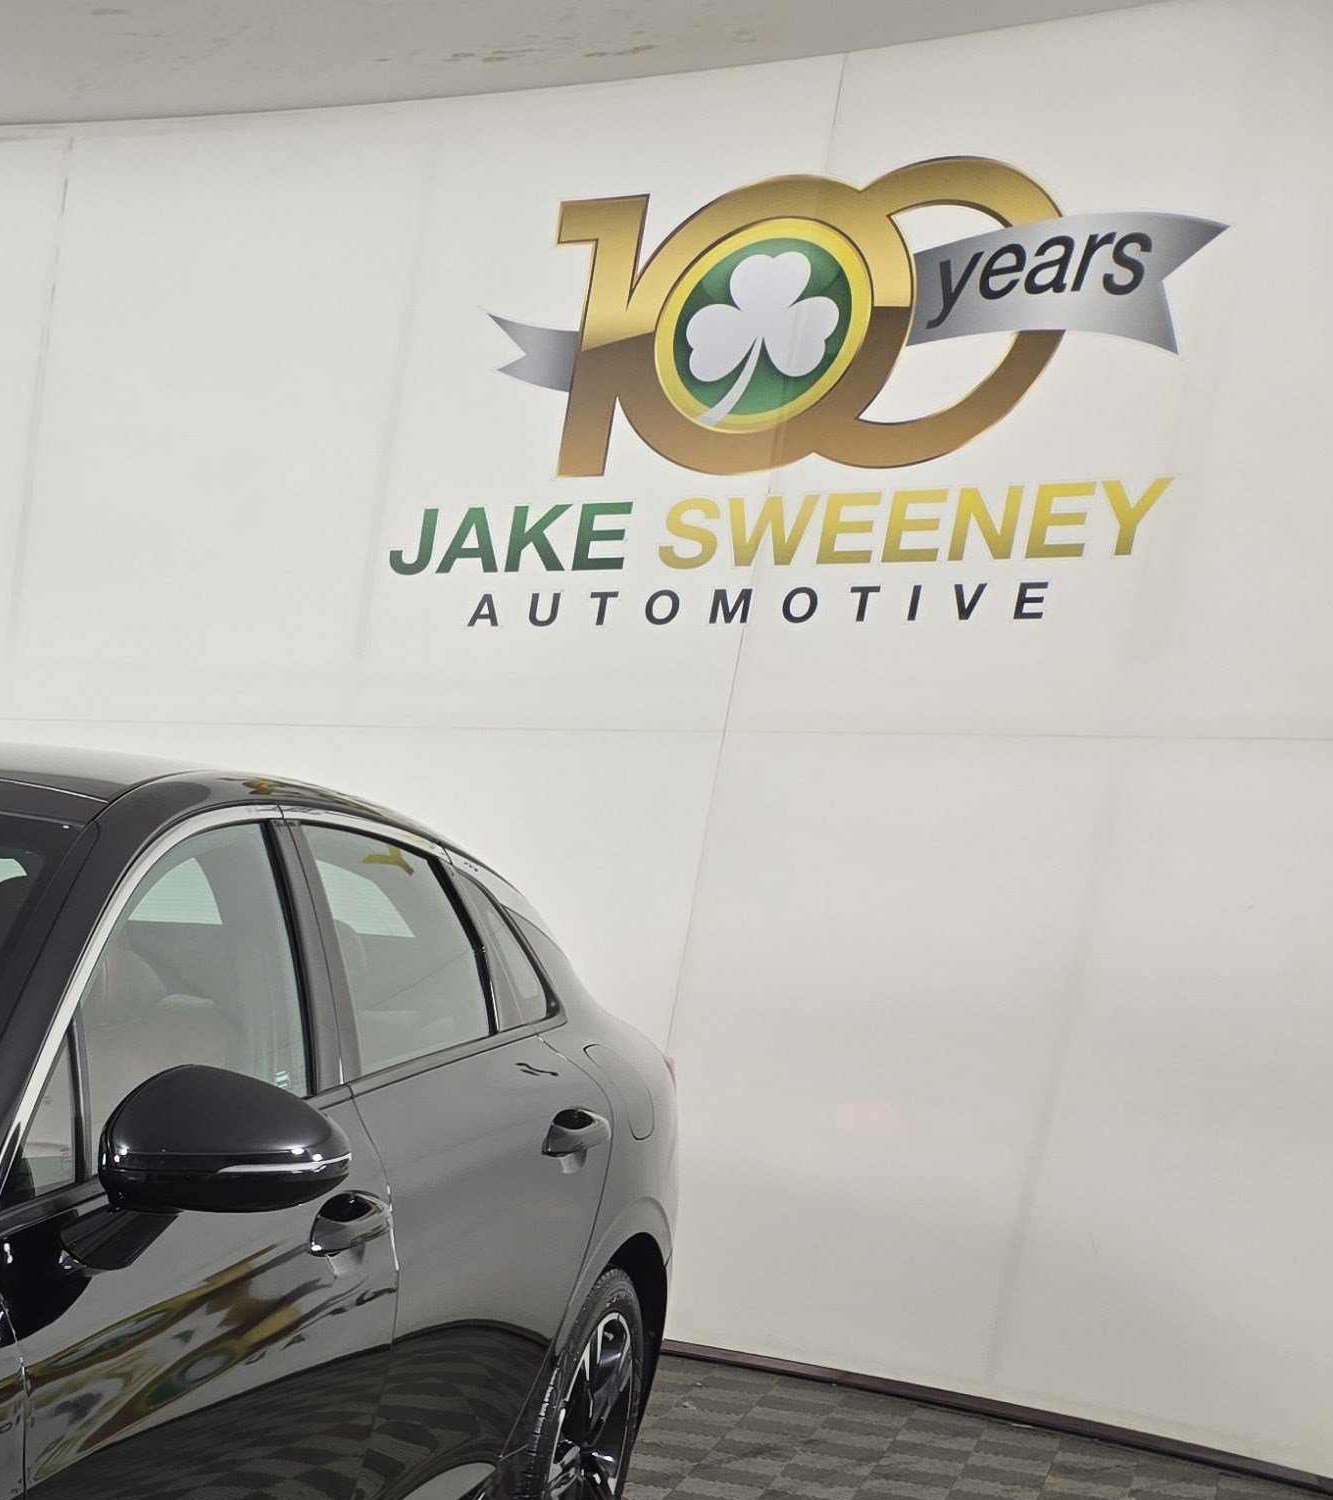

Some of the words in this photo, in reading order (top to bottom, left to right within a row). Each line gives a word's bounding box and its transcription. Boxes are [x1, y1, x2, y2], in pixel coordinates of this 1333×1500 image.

[926, 229, 1153, 329] years
[389, 501, 633, 576] JAKE
[658, 477, 1173, 569] SWEENEY
[468, 582, 1049, 628] AUTOMOTIVE
